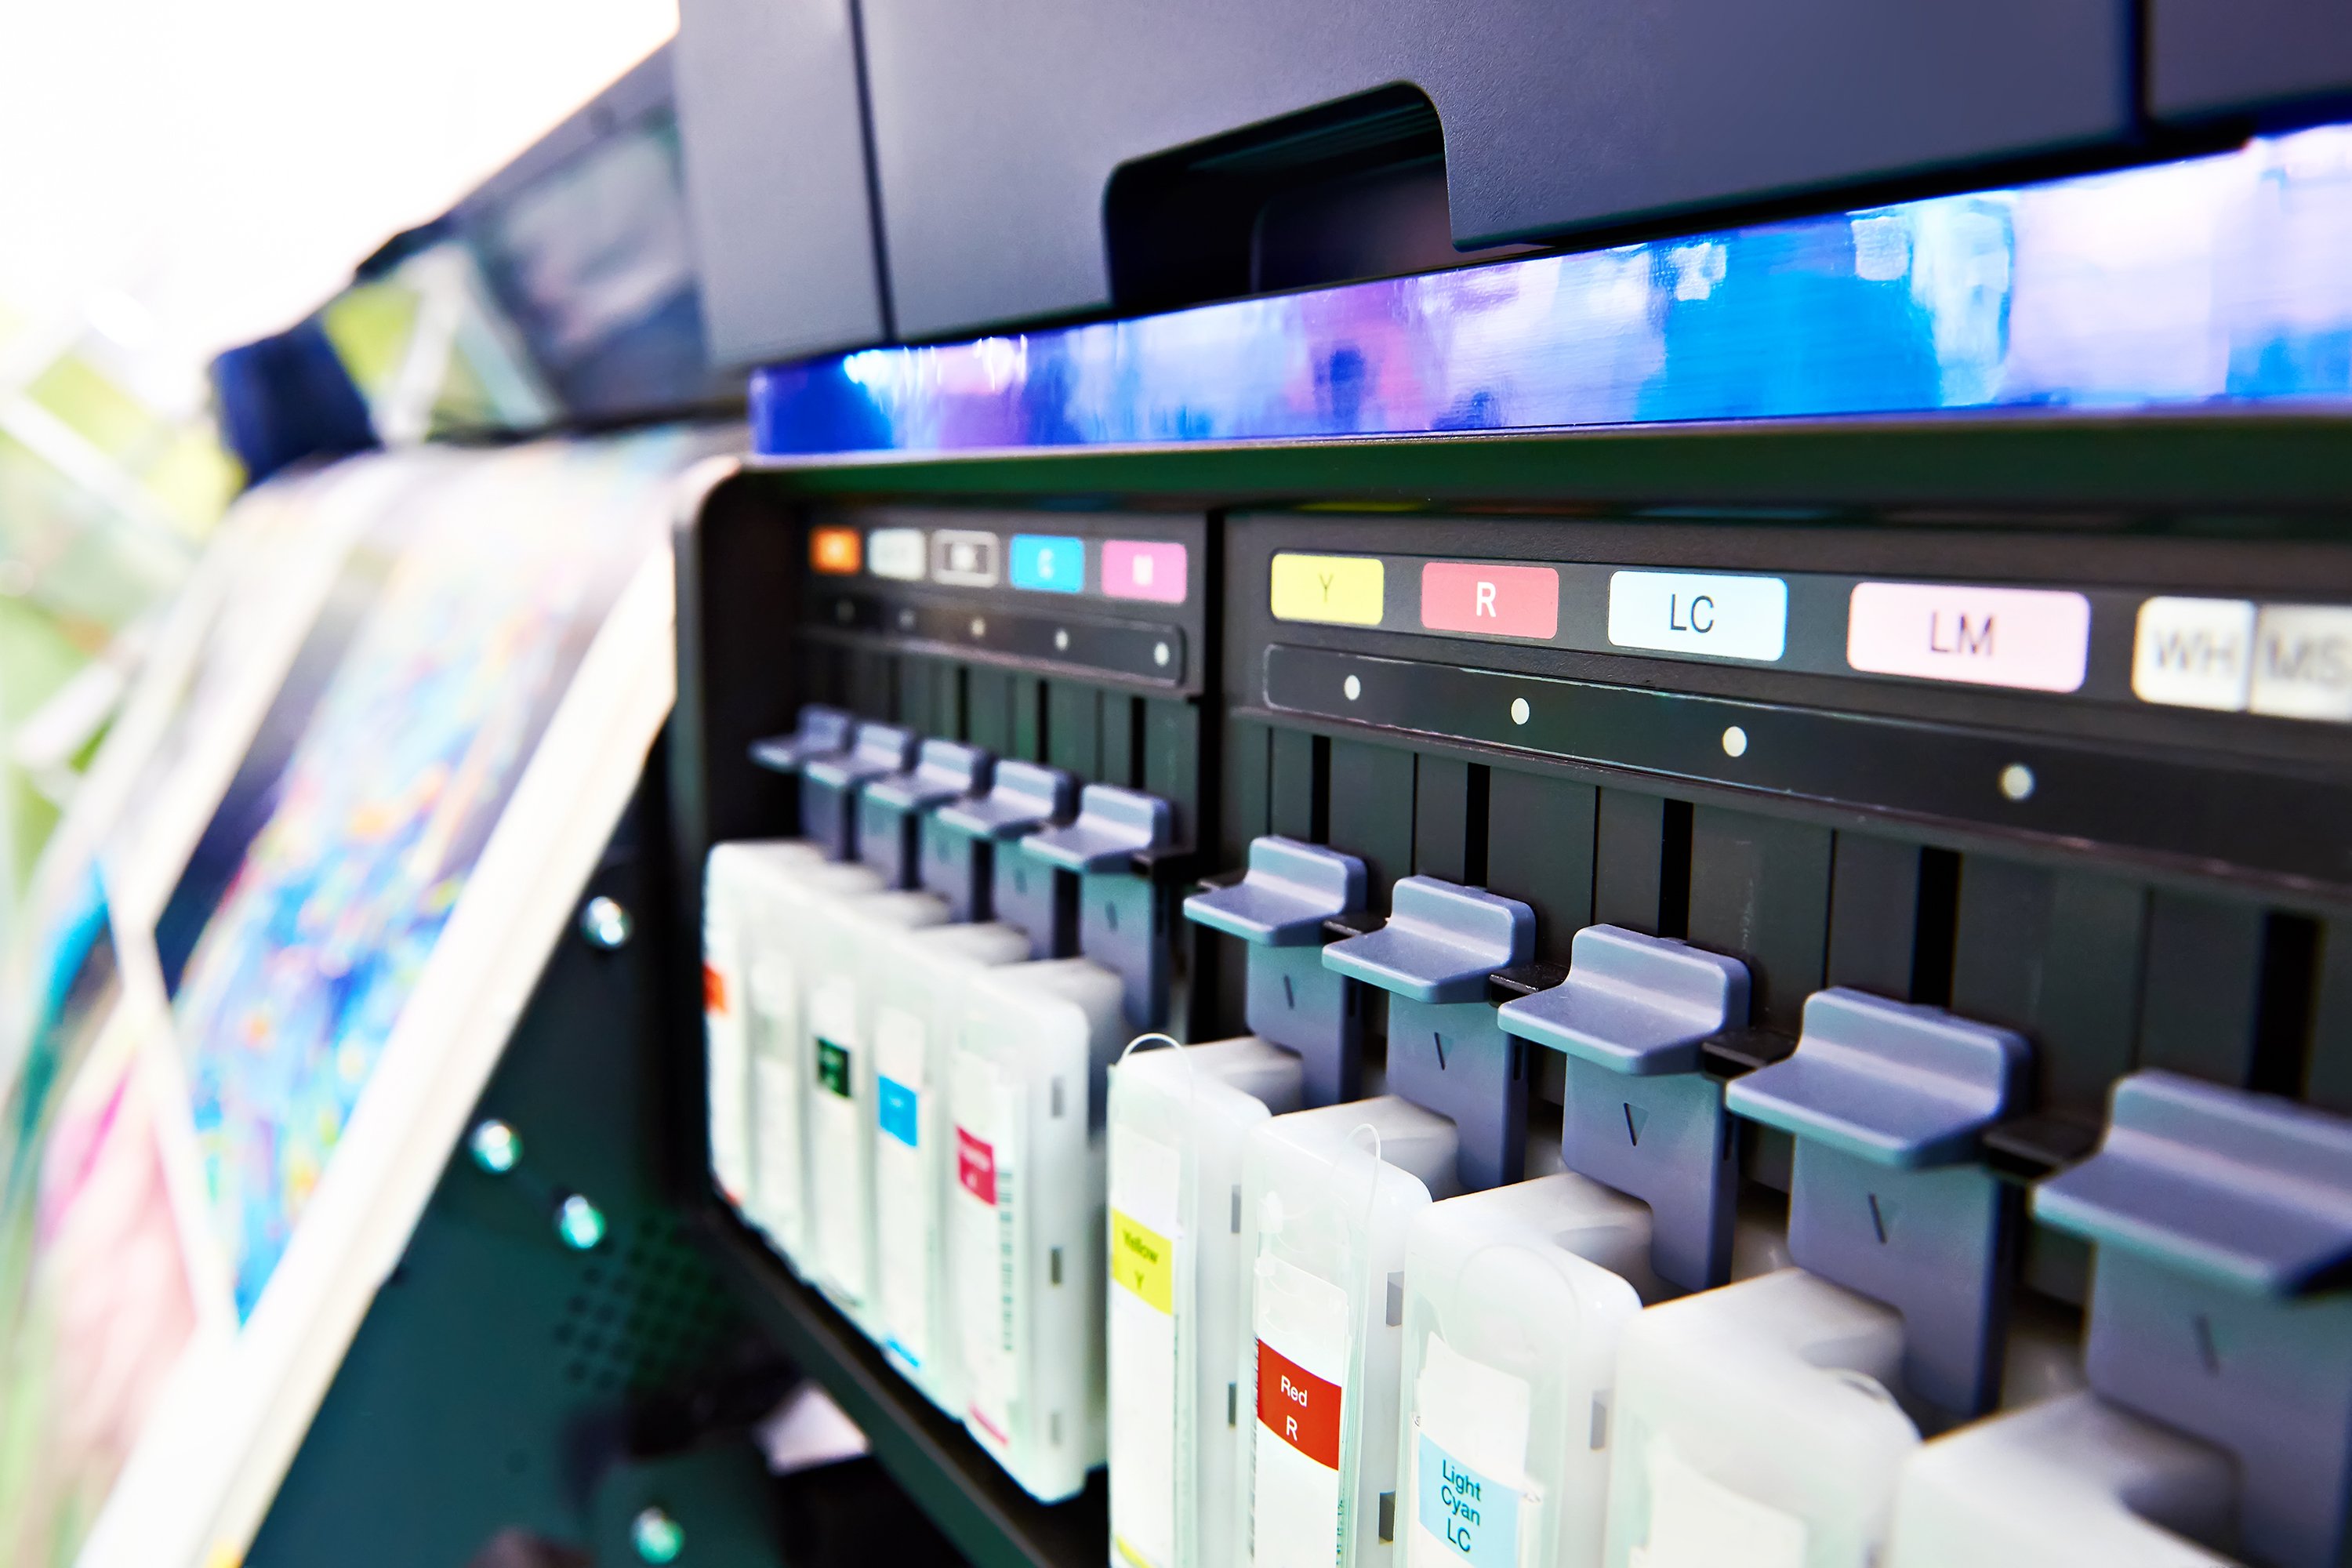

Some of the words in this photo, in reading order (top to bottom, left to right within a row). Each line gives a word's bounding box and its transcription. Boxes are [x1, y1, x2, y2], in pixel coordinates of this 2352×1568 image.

[1319, 573, 1334, 602] Y
[1475, 581, 1497, 618] R
[1669, 593, 1715, 633] LC
[1930, 611, 1994, 656] LM
[2154, 630, 2241, 679] WH
[1122, 1228, 1158, 1265] Yellow
[1134, 1269, 1145, 1290] Y
[1280, 1374, 1308, 1408] Red
[1286, 1415, 1298, 1441] R
[1442, 1459, 1481, 1501] Light
[1441, 1485, 1480, 1526] Cyan
[1446, 1517, 1472, 1552] LC
